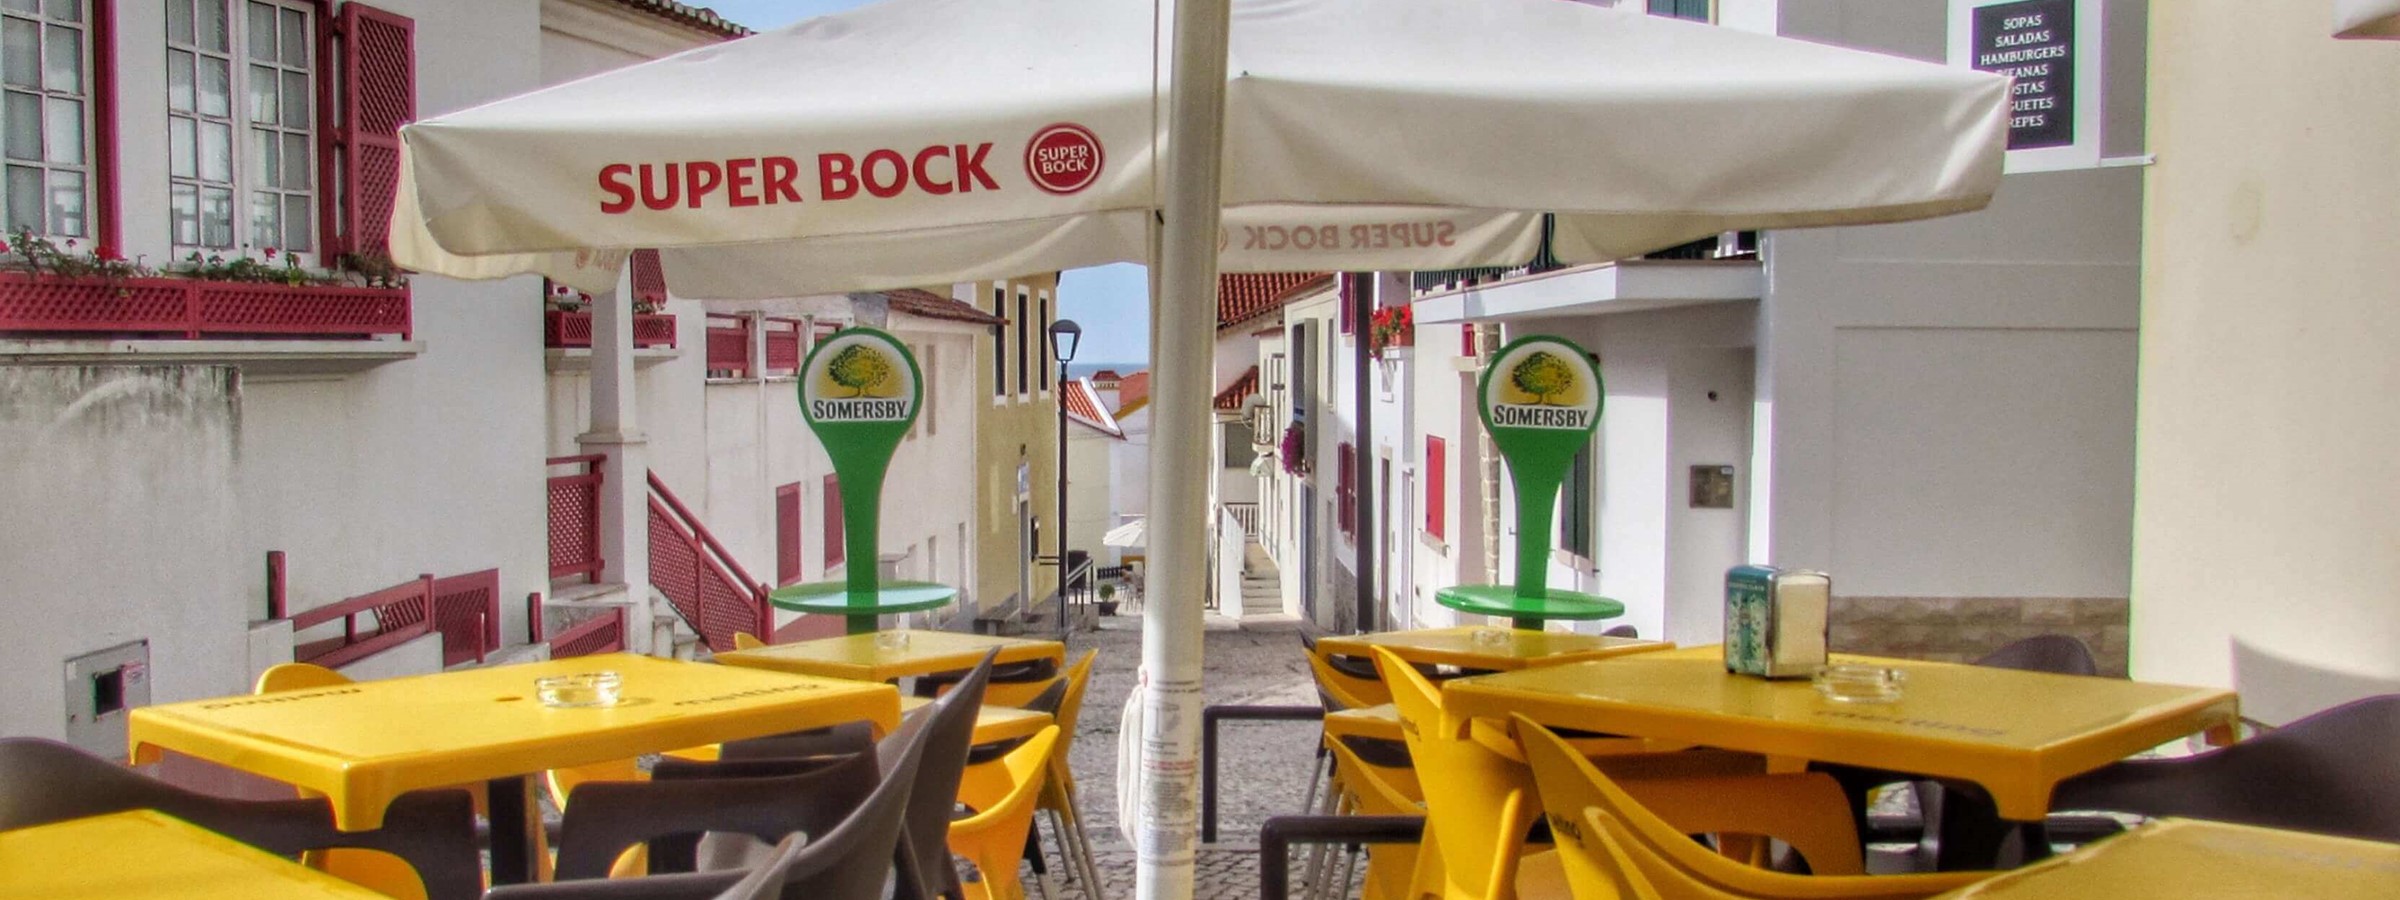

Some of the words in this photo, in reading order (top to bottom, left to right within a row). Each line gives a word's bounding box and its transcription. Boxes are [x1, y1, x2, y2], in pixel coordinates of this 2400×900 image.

[2003, 15, 2042, 30] SOPAS
[1995, 30, 2050, 48] SALADAS
[1980, 45, 2065, 66] HAMBURGERS
[1038, 144, 1088, 162] SUPER
[1042, 158, 1088, 175] BOCK
[598, 156, 803, 214] SUPER
[818, 142, 1001, 200] BOCK
